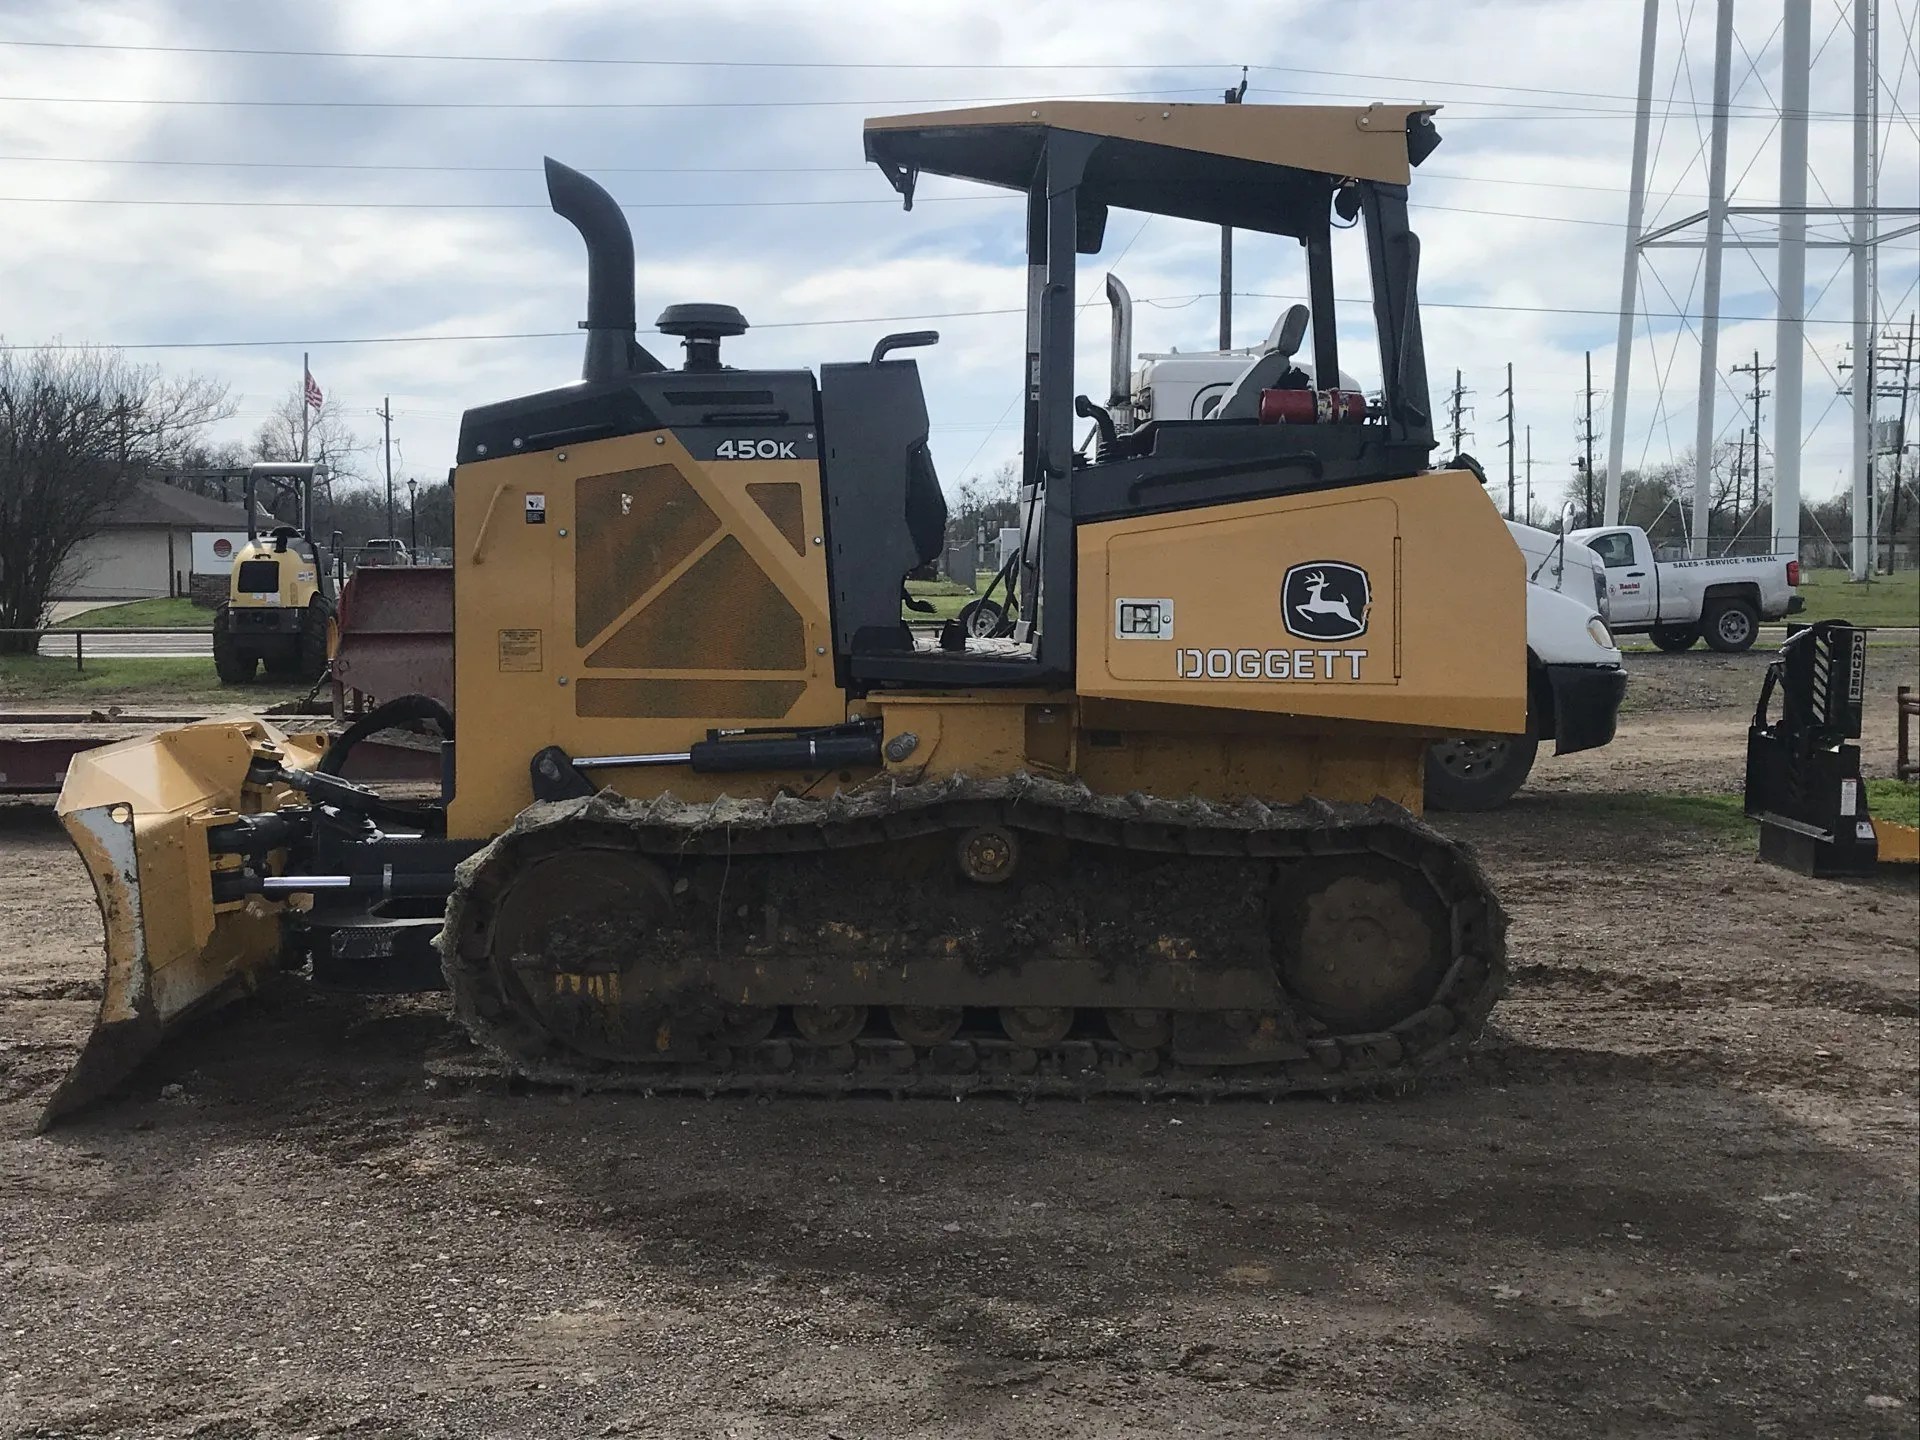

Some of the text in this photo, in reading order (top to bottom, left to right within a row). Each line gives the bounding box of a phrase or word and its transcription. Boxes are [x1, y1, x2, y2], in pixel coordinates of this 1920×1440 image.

[715, 439, 798, 460] 450K
[1672, 555, 1778, 569] SALES SERVICE RENTAL
[1175, 648, 1368, 679] DOGGETT
[1850, 635, 1863, 696] DANUSER
